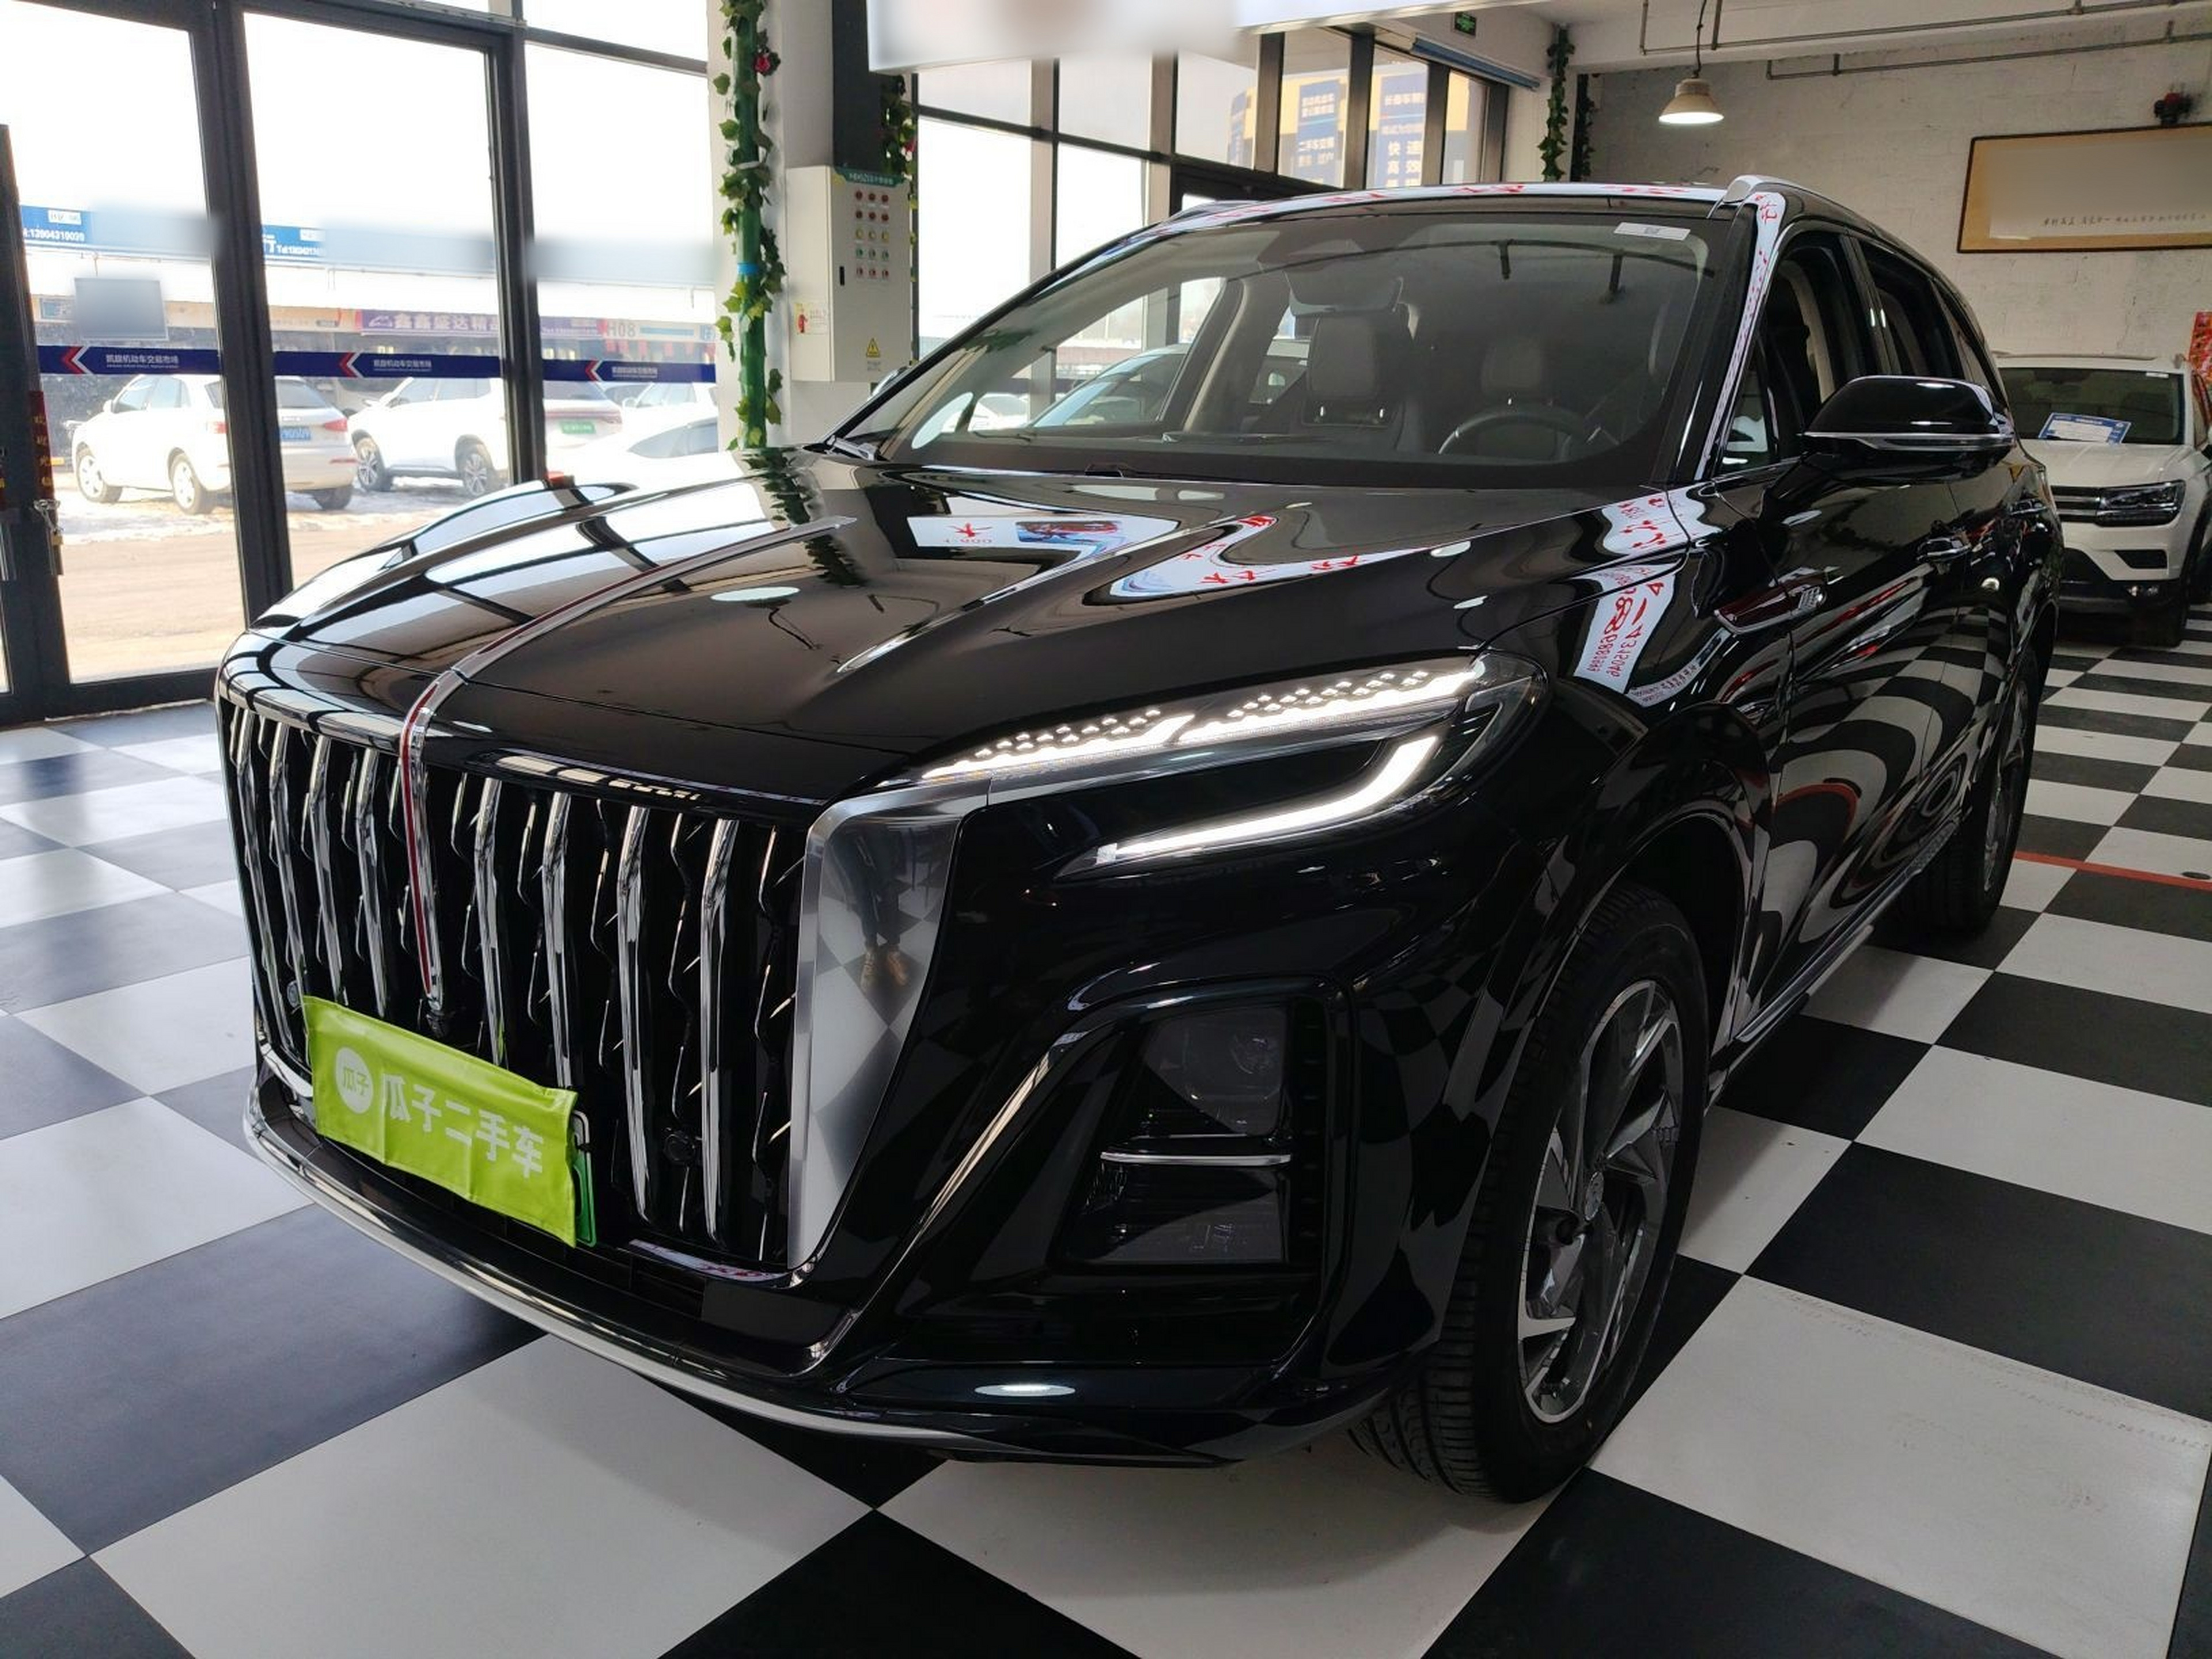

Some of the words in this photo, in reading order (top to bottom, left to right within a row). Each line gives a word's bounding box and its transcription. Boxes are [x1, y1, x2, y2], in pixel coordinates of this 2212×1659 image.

[607, 321, 637, 338] H08
[342, 1065, 369, 1096] 瓜子
[382, 1073, 543, 1179] 瓜子二手车
